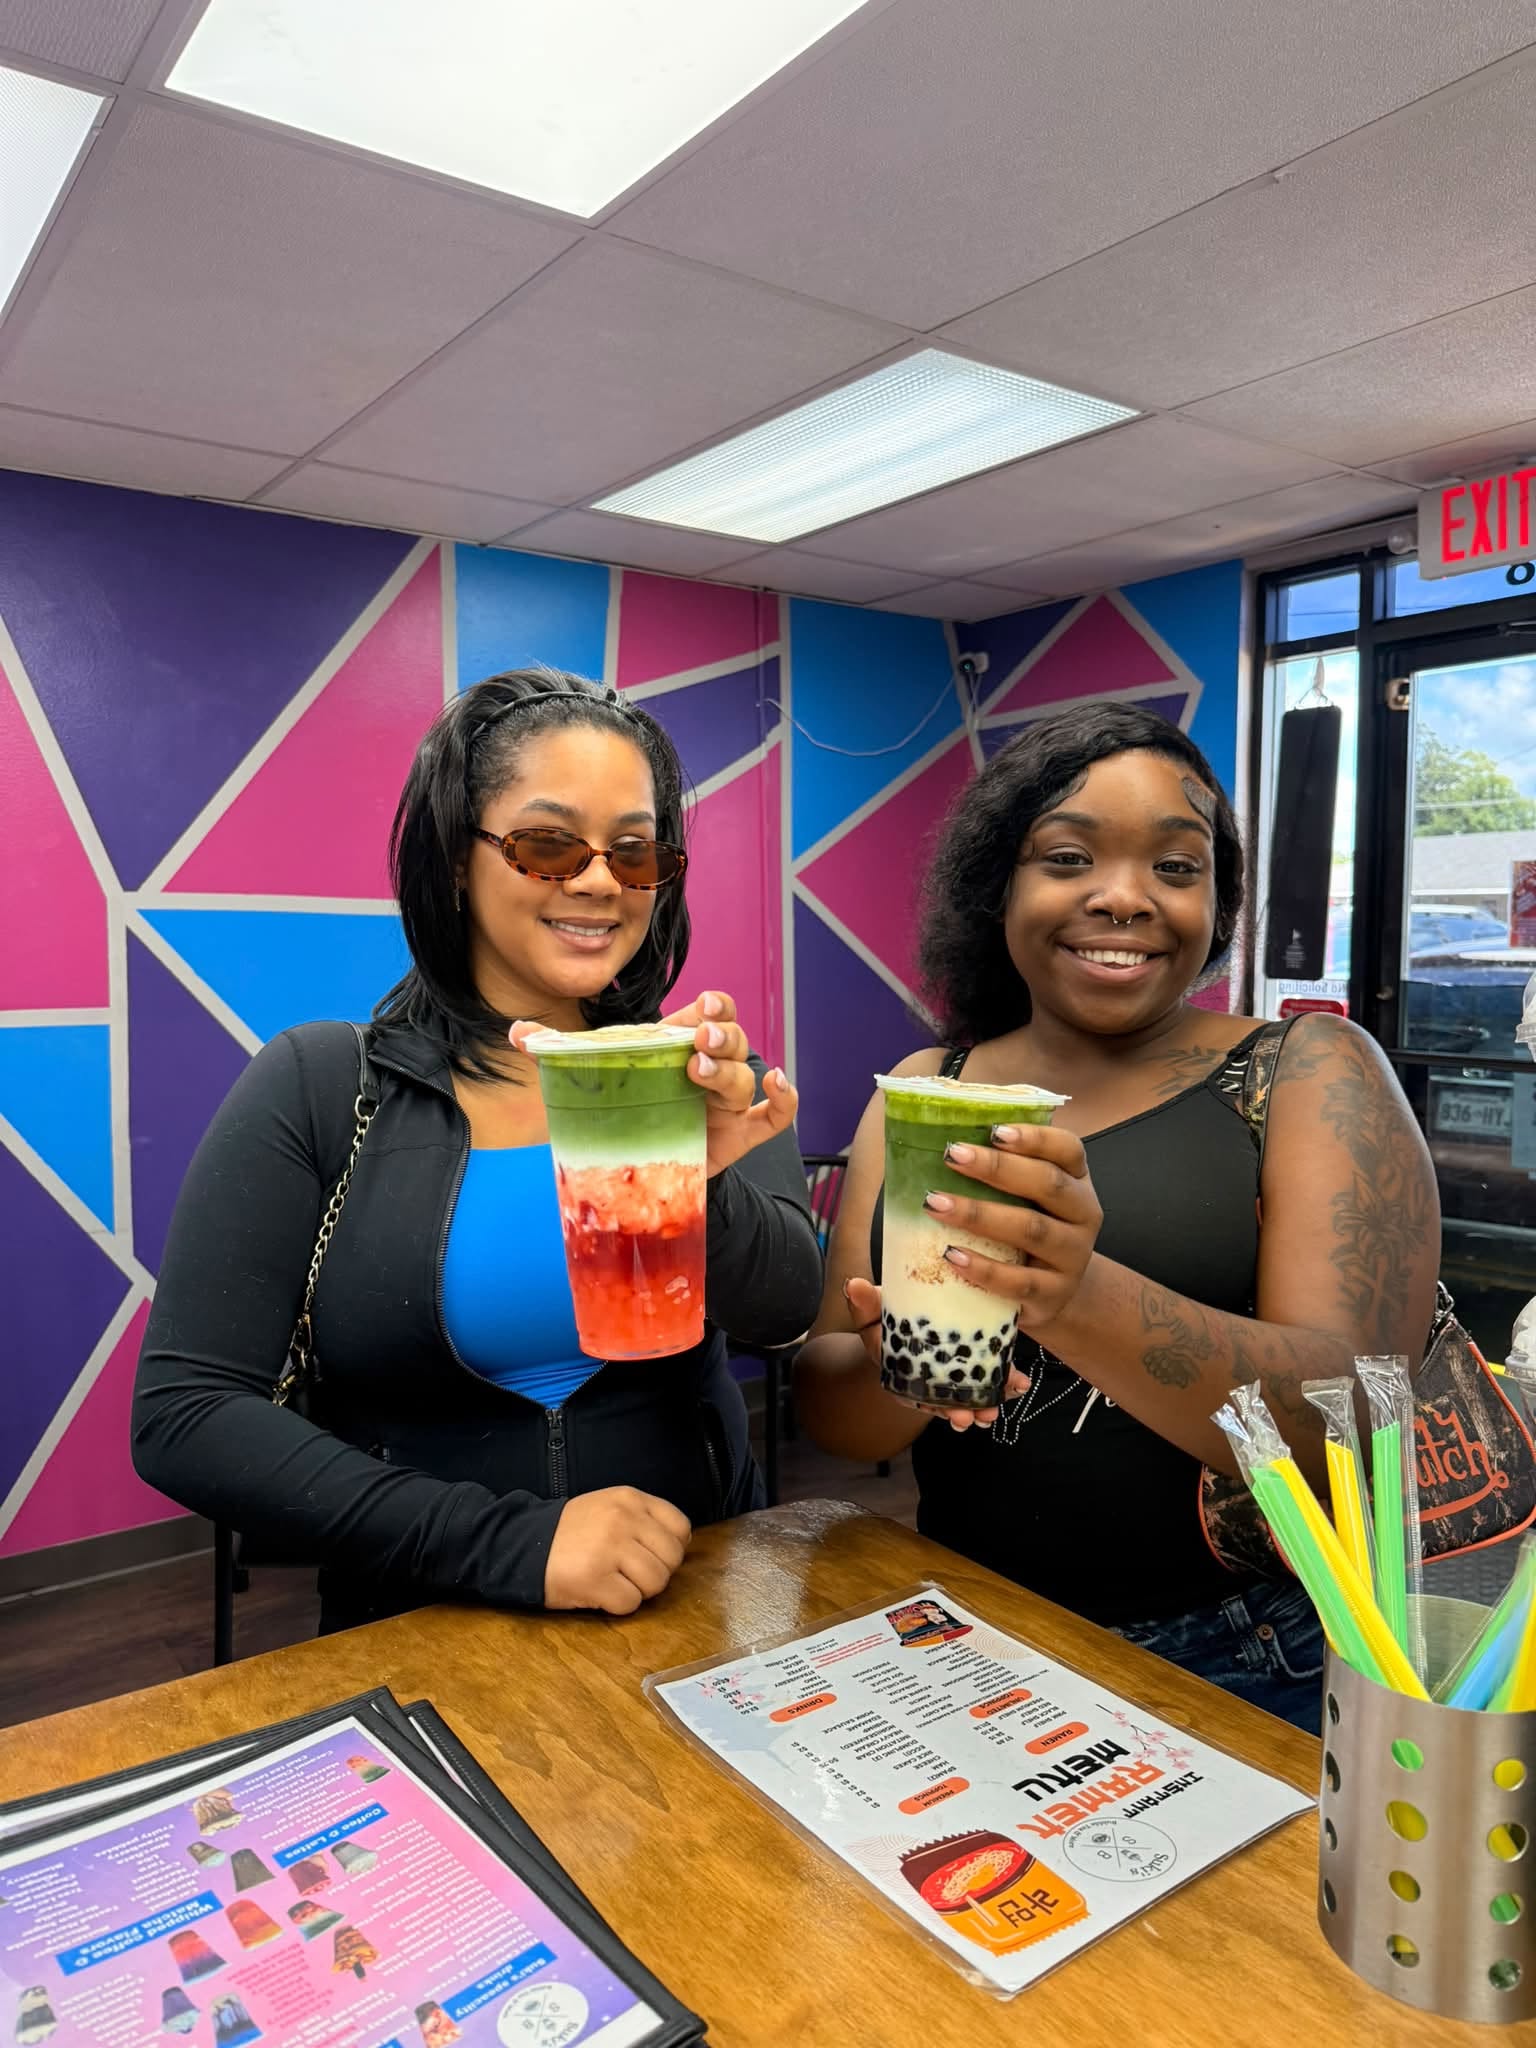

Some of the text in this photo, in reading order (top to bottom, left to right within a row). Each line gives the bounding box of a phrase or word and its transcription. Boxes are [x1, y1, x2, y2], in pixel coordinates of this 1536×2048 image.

[1441, 466, 1536, 564] EXIT
[1413, 1410, 1509, 1488] utch
[781, 1659, 805, 1670] MELON
[783, 1654, 799, 1663] MILK
[786, 1664, 810, 1676] COFFEE
[991, 1665, 1006, 1673] RED
[774, 1669, 815, 1688] STRAWBERRY
[799, 1679, 828, 1691] BANANA
[803, 1675, 821, 1684] TARO
[870, 1671, 904, 1687] SOY SAUCE
[787, 1697, 823, 1714] DRINKS
[978, 1691, 1015, 1709] TOPPINGS
[986, 1696, 1025, 1715] UNLIMITED
[1015, 1696, 1044, 1712] PREMIUM
[1037, 1701, 1052, 1709] RED
[855, 1709, 875, 1720] PORK
[1020, 1707, 1039, 1718] SHELF
[1020, 1714, 1040, 1726] SHELF
[1038, 1705, 1059, 1717] BLACK
[822, 1718, 855, 1734] SAUSAGE
[846, 1714, 882, 1732] EDAMAME
[862, 1719, 889, 1733] SHRIMP
[1033, 1717, 1053, 1728] SHELF
[874, 1734, 911, 1752] IMITATION
[879, 1728, 904, 1742] HEAVY
[1040, 1729, 1074, 1747] RAMEN
[853, 1739, 880, 1753] CREAM
[855, 1749, 876, 1761] CRAB
[881, 1738, 919, 1757] DUMPLING
[916, 1749, 934, 1760] RICE
[892, 1757, 917, 1770] CAKES
[931, 1760, 949, 1770] HAM
[1013, 1739, 1128, 1800] MENU
[855, 1754, 941, 1797] CHEESE $2
[913, 1783, 948, 1801] TOPPINGS
[922, 1789, 955, 1807] PREMIUM
[1016, 1760, 1166, 1840] RAMEN
[1123, 1771, 1203, 1818] INSTANT
[339, 1806, 382, 1832] Coffee
[283, 1835, 328, 1860] Lattes
[1096, 1835, 1137, 1860] S B
[1128, 1852, 1169, 1878] Suki's
[140, 1899, 200, 1931] Matcha
[998, 1888, 1059, 1927] 라면
[145, 1901, 214, 1937] Whipped
[78, 1925, 139, 1957] Flavors
[90, 1931, 144, 1961] coffee
[473, 1963, 516, 1991] drinks
[507, 1956, 548, 1984] Suki's
